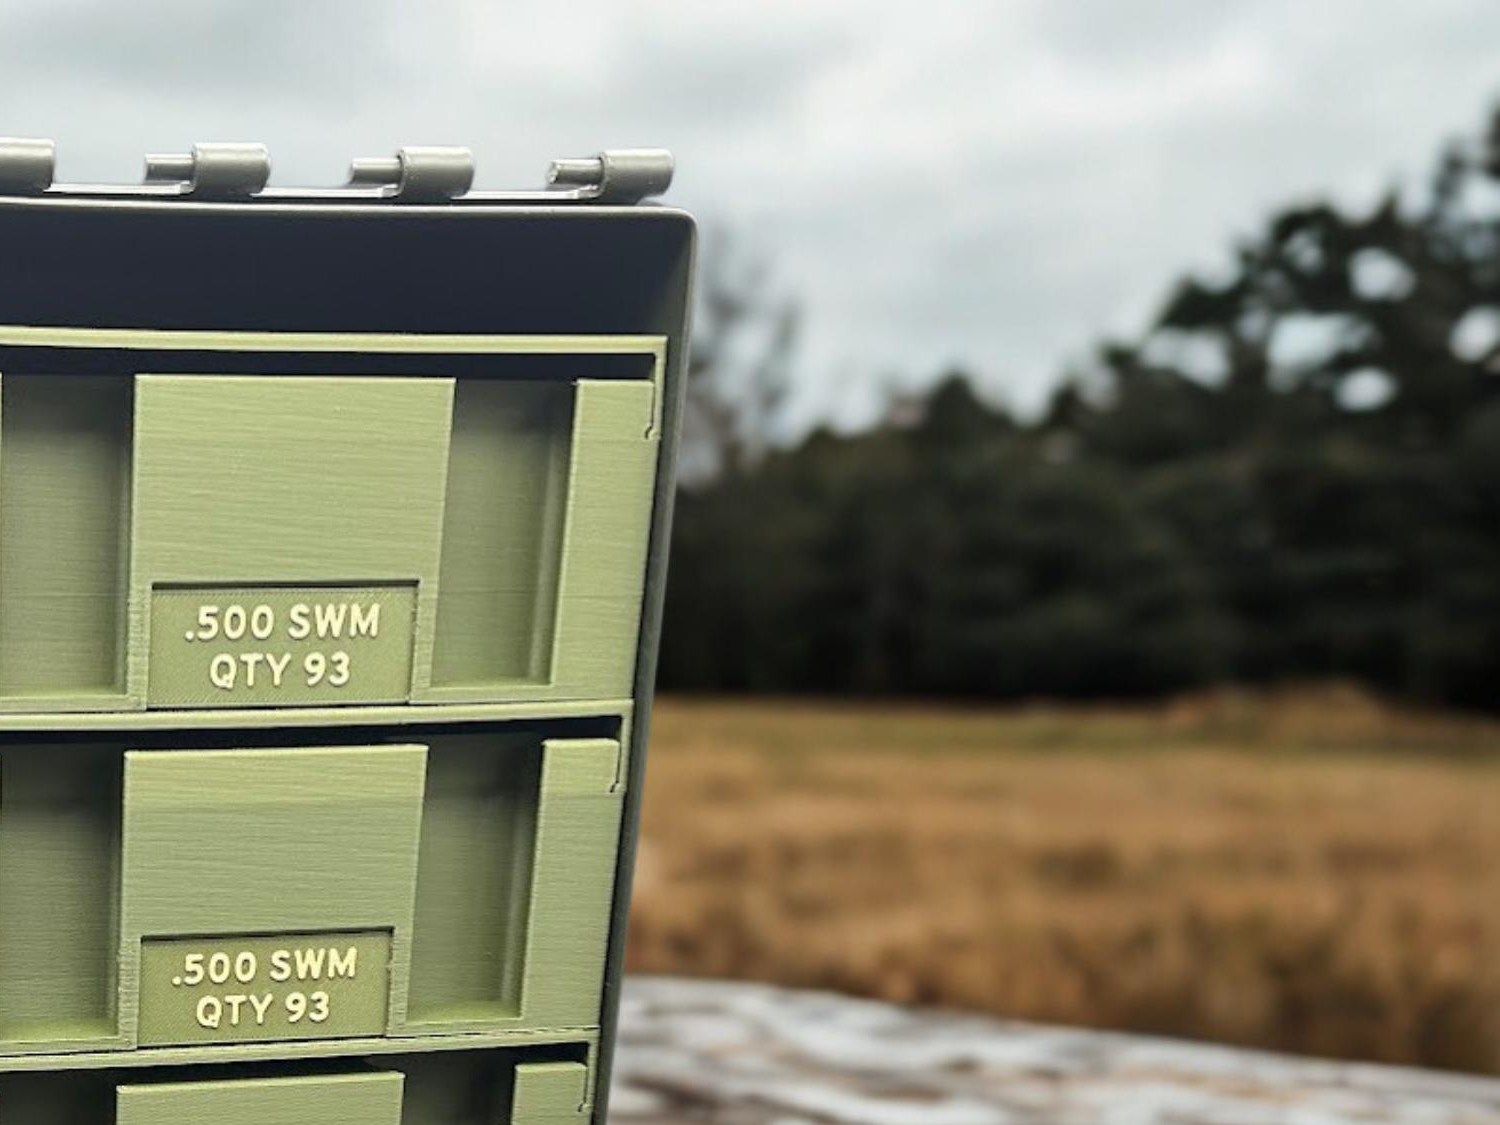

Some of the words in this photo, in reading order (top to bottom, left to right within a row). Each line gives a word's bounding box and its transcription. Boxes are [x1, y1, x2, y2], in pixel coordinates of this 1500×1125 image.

[184, 602, 275, 640] .500
[288, 601, 382, 638] SWM
[209, 651, 293, 690] QTY
[303, 649, 351, 686] 93
[172, 949, 258, 986] .500
[269, 945, 359, 982] SWM
[195, 991, 275, 1029] QTY
[284, 989, 331, 1023] 93
